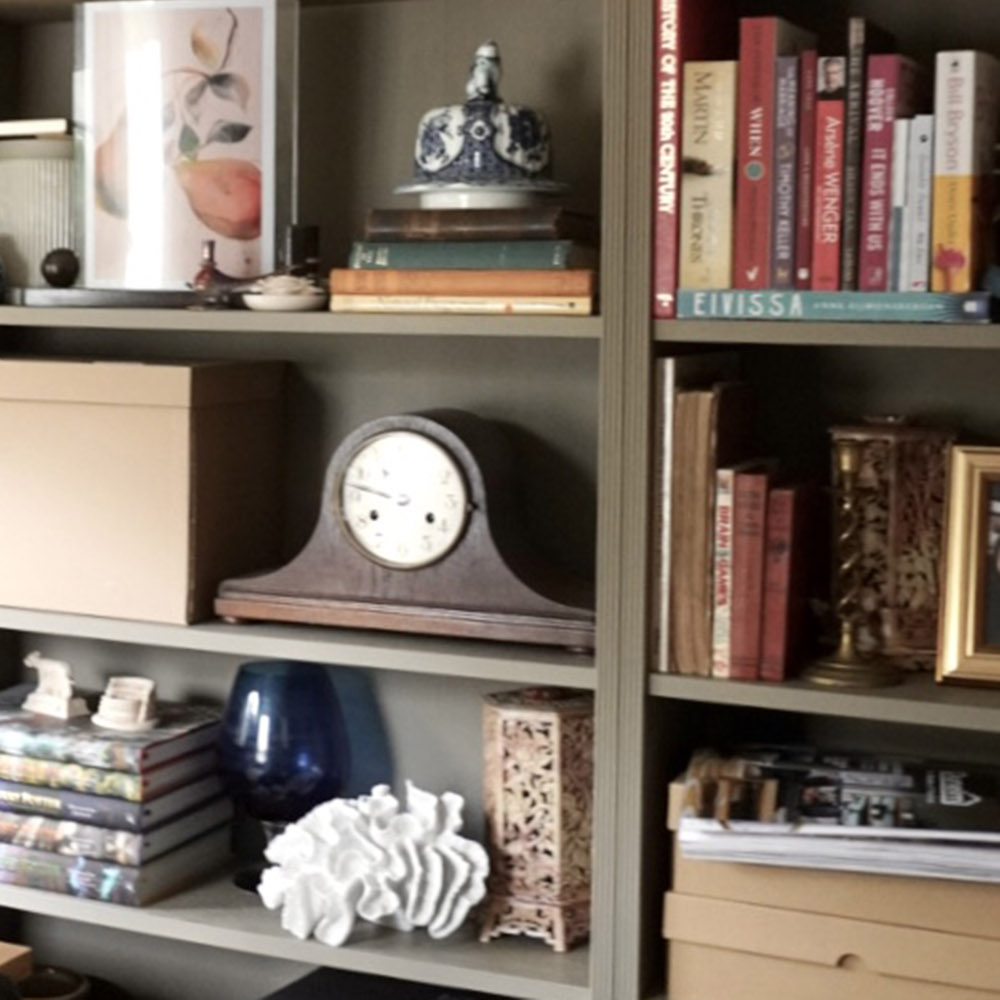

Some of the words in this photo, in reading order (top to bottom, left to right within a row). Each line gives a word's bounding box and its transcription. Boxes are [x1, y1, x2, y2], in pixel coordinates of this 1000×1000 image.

[660, 55, 677, 75] OF
[660, 79, 677, 108] THE
[867, 78, 885, 132] HOOVER
[946, 76, 963, 105] Bill
[748, 107, 764, 157] WHEN
[823, 116, 842, 170] Arsène
[942, 110, 963, 171] Bryson
[870, 149, 886, 160] IT
[657, 144, 676, 214] CENTURY
[778, 163, 790, 215] TIMOTHY
[868, 163, 885, 196] ENDS
[822, 172, 840, 243] WENGER
[867, 199, 885, 231] WITH
[776, 219, 789, 259] KELLER
[867, 234, 883, 251] US
[693, 293, 803, 317] EIVISSA
[718, 505, 730, 548] BRAIN
[717, 558, 729, 606] GAMES
